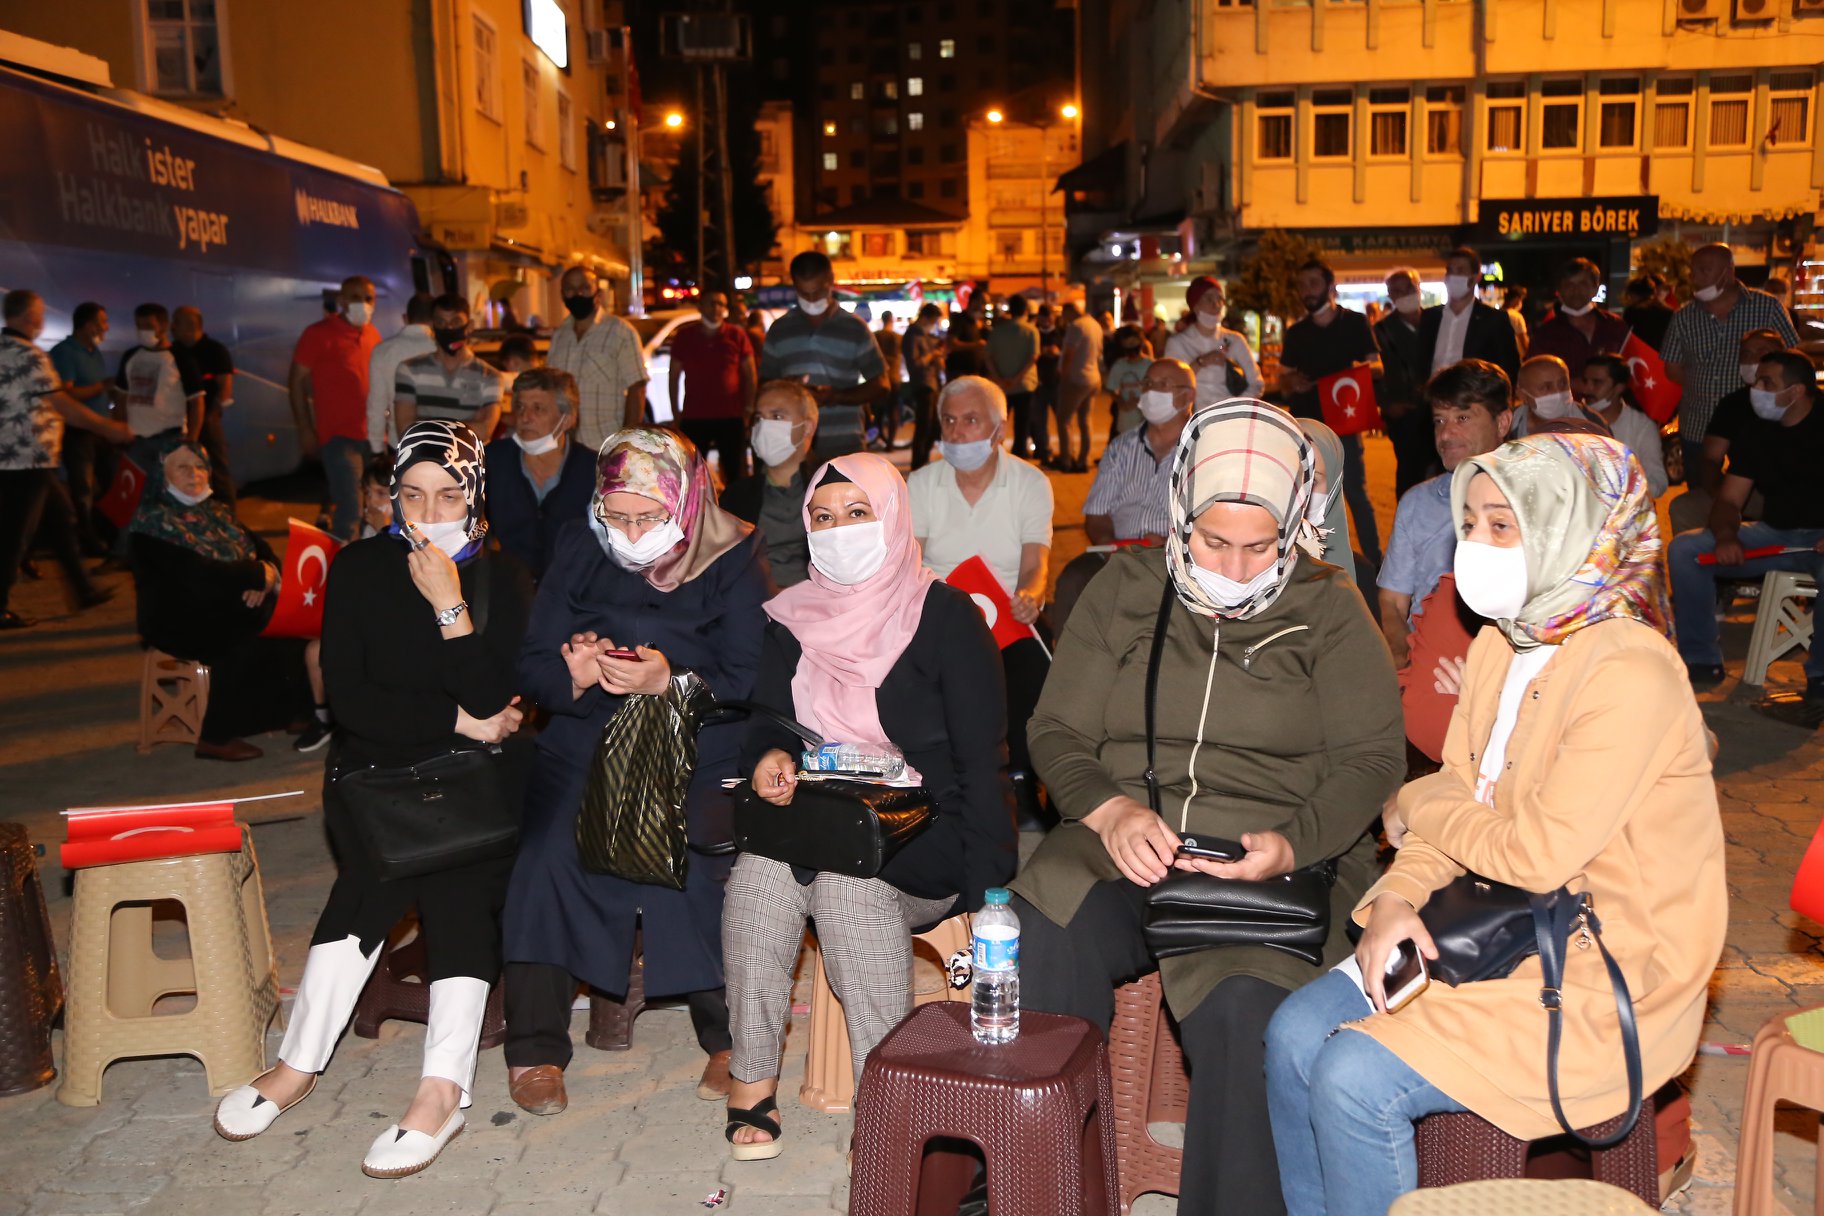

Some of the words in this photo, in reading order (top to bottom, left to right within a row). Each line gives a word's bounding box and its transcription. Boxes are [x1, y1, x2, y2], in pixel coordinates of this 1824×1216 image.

[88, 122, 145, 180] Halk
[145, 137, 196, 191] ister
[57, 171, 173, 236] Halkbank
[174, 204, 229, 253] yapar
[1499, 210, 1574, 234] SARIYER
[1580, 205, 1640, 232] BÖREK
